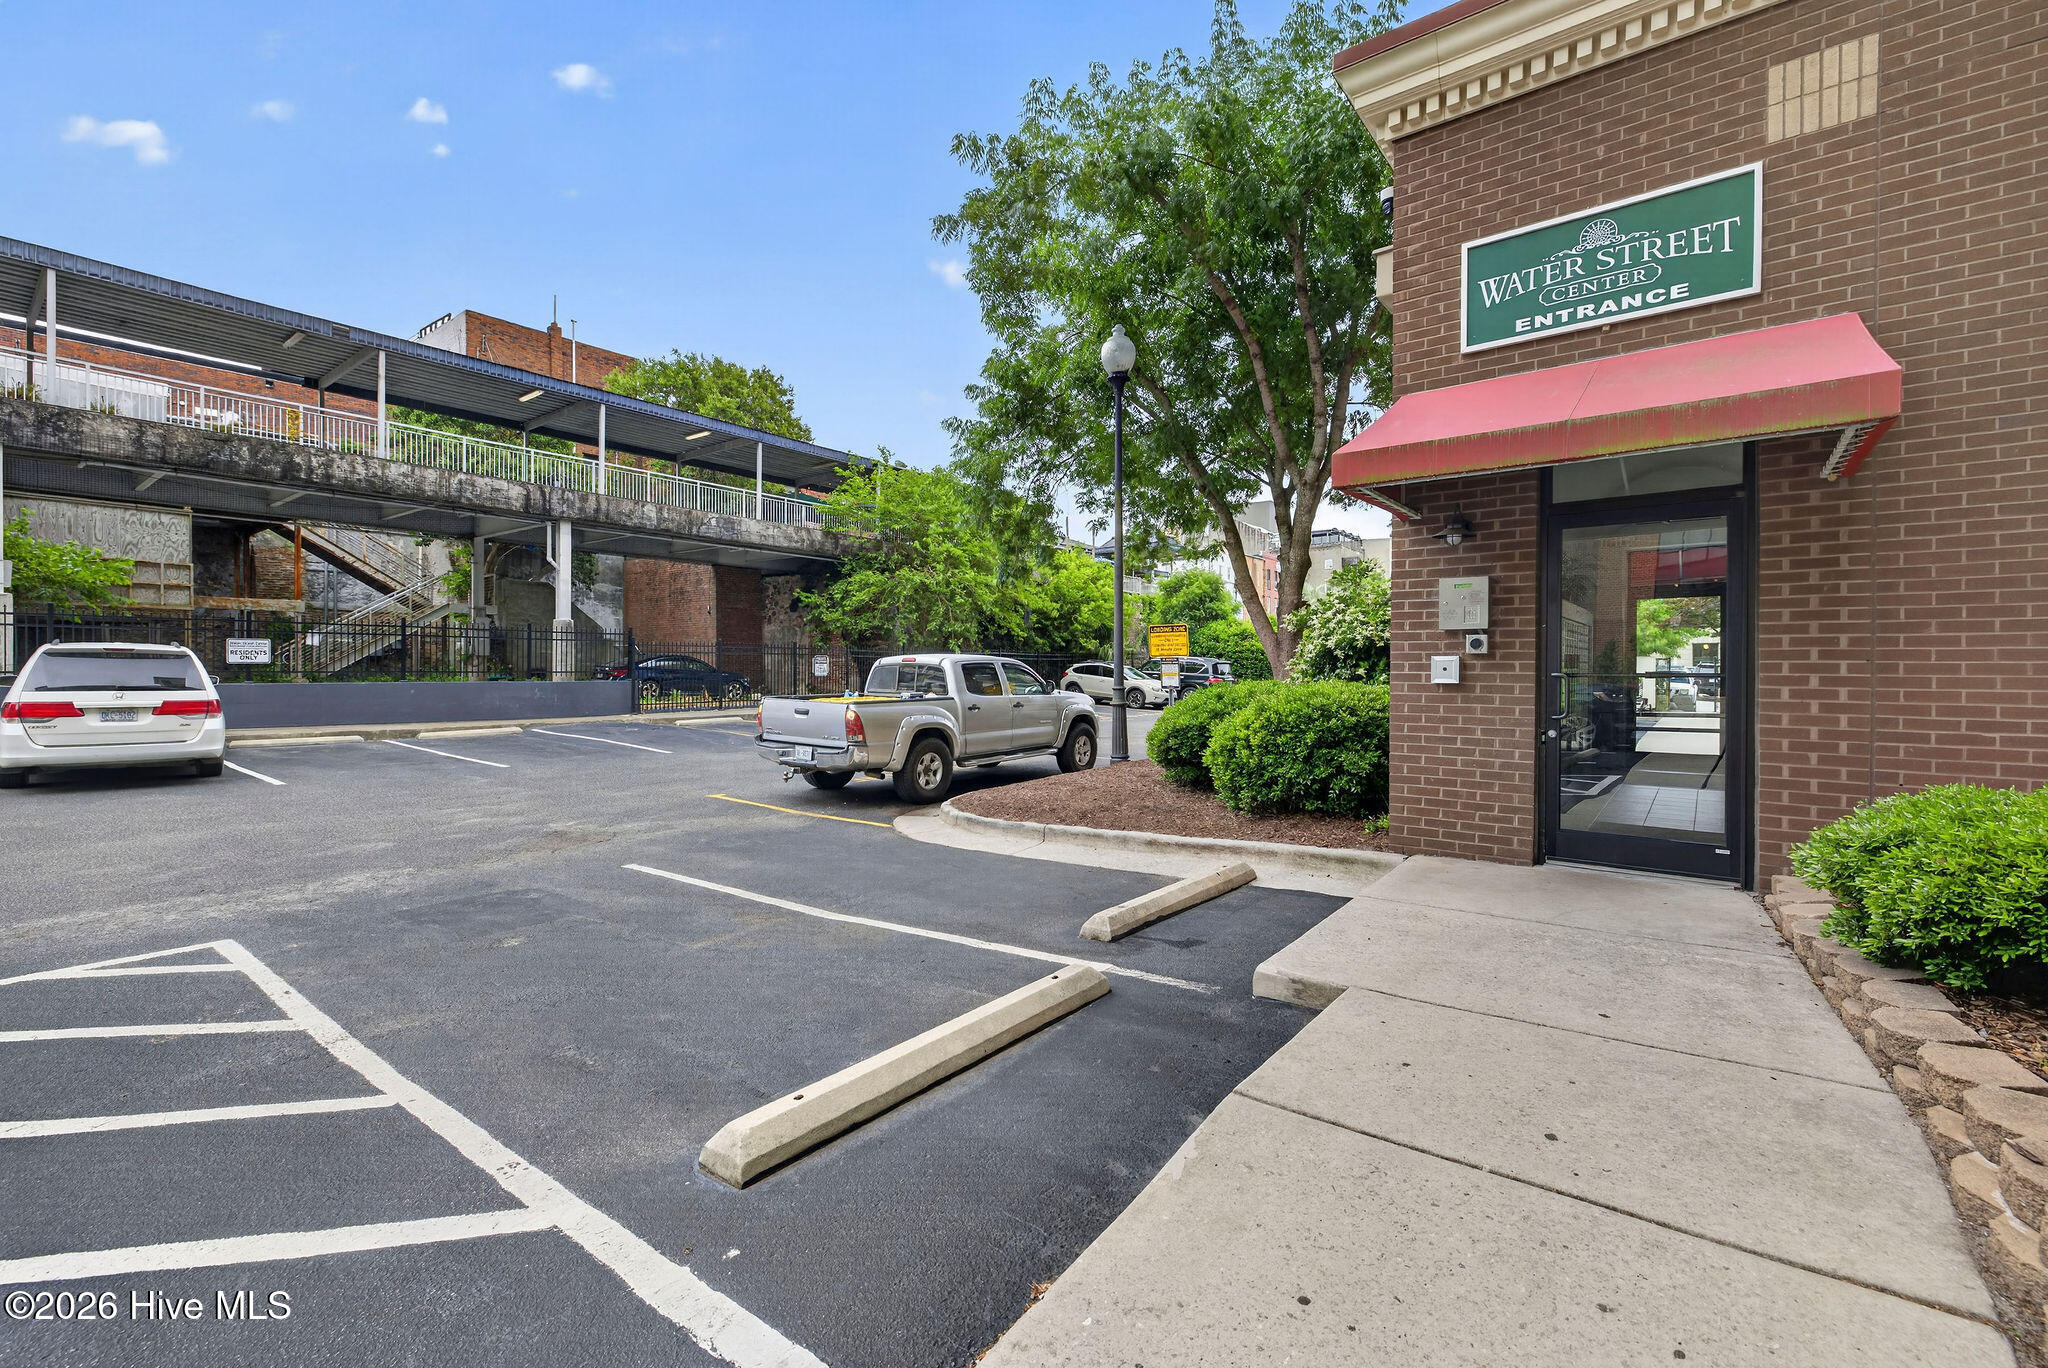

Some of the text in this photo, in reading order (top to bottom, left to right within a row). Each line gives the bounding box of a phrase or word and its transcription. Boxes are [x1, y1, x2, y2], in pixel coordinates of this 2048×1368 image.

[1478, 216, 1740, 309] WATER STREET
[1551, 268, 1647, 301] CENTER
[1515, 282, 1690, 332] ENTRANCE
